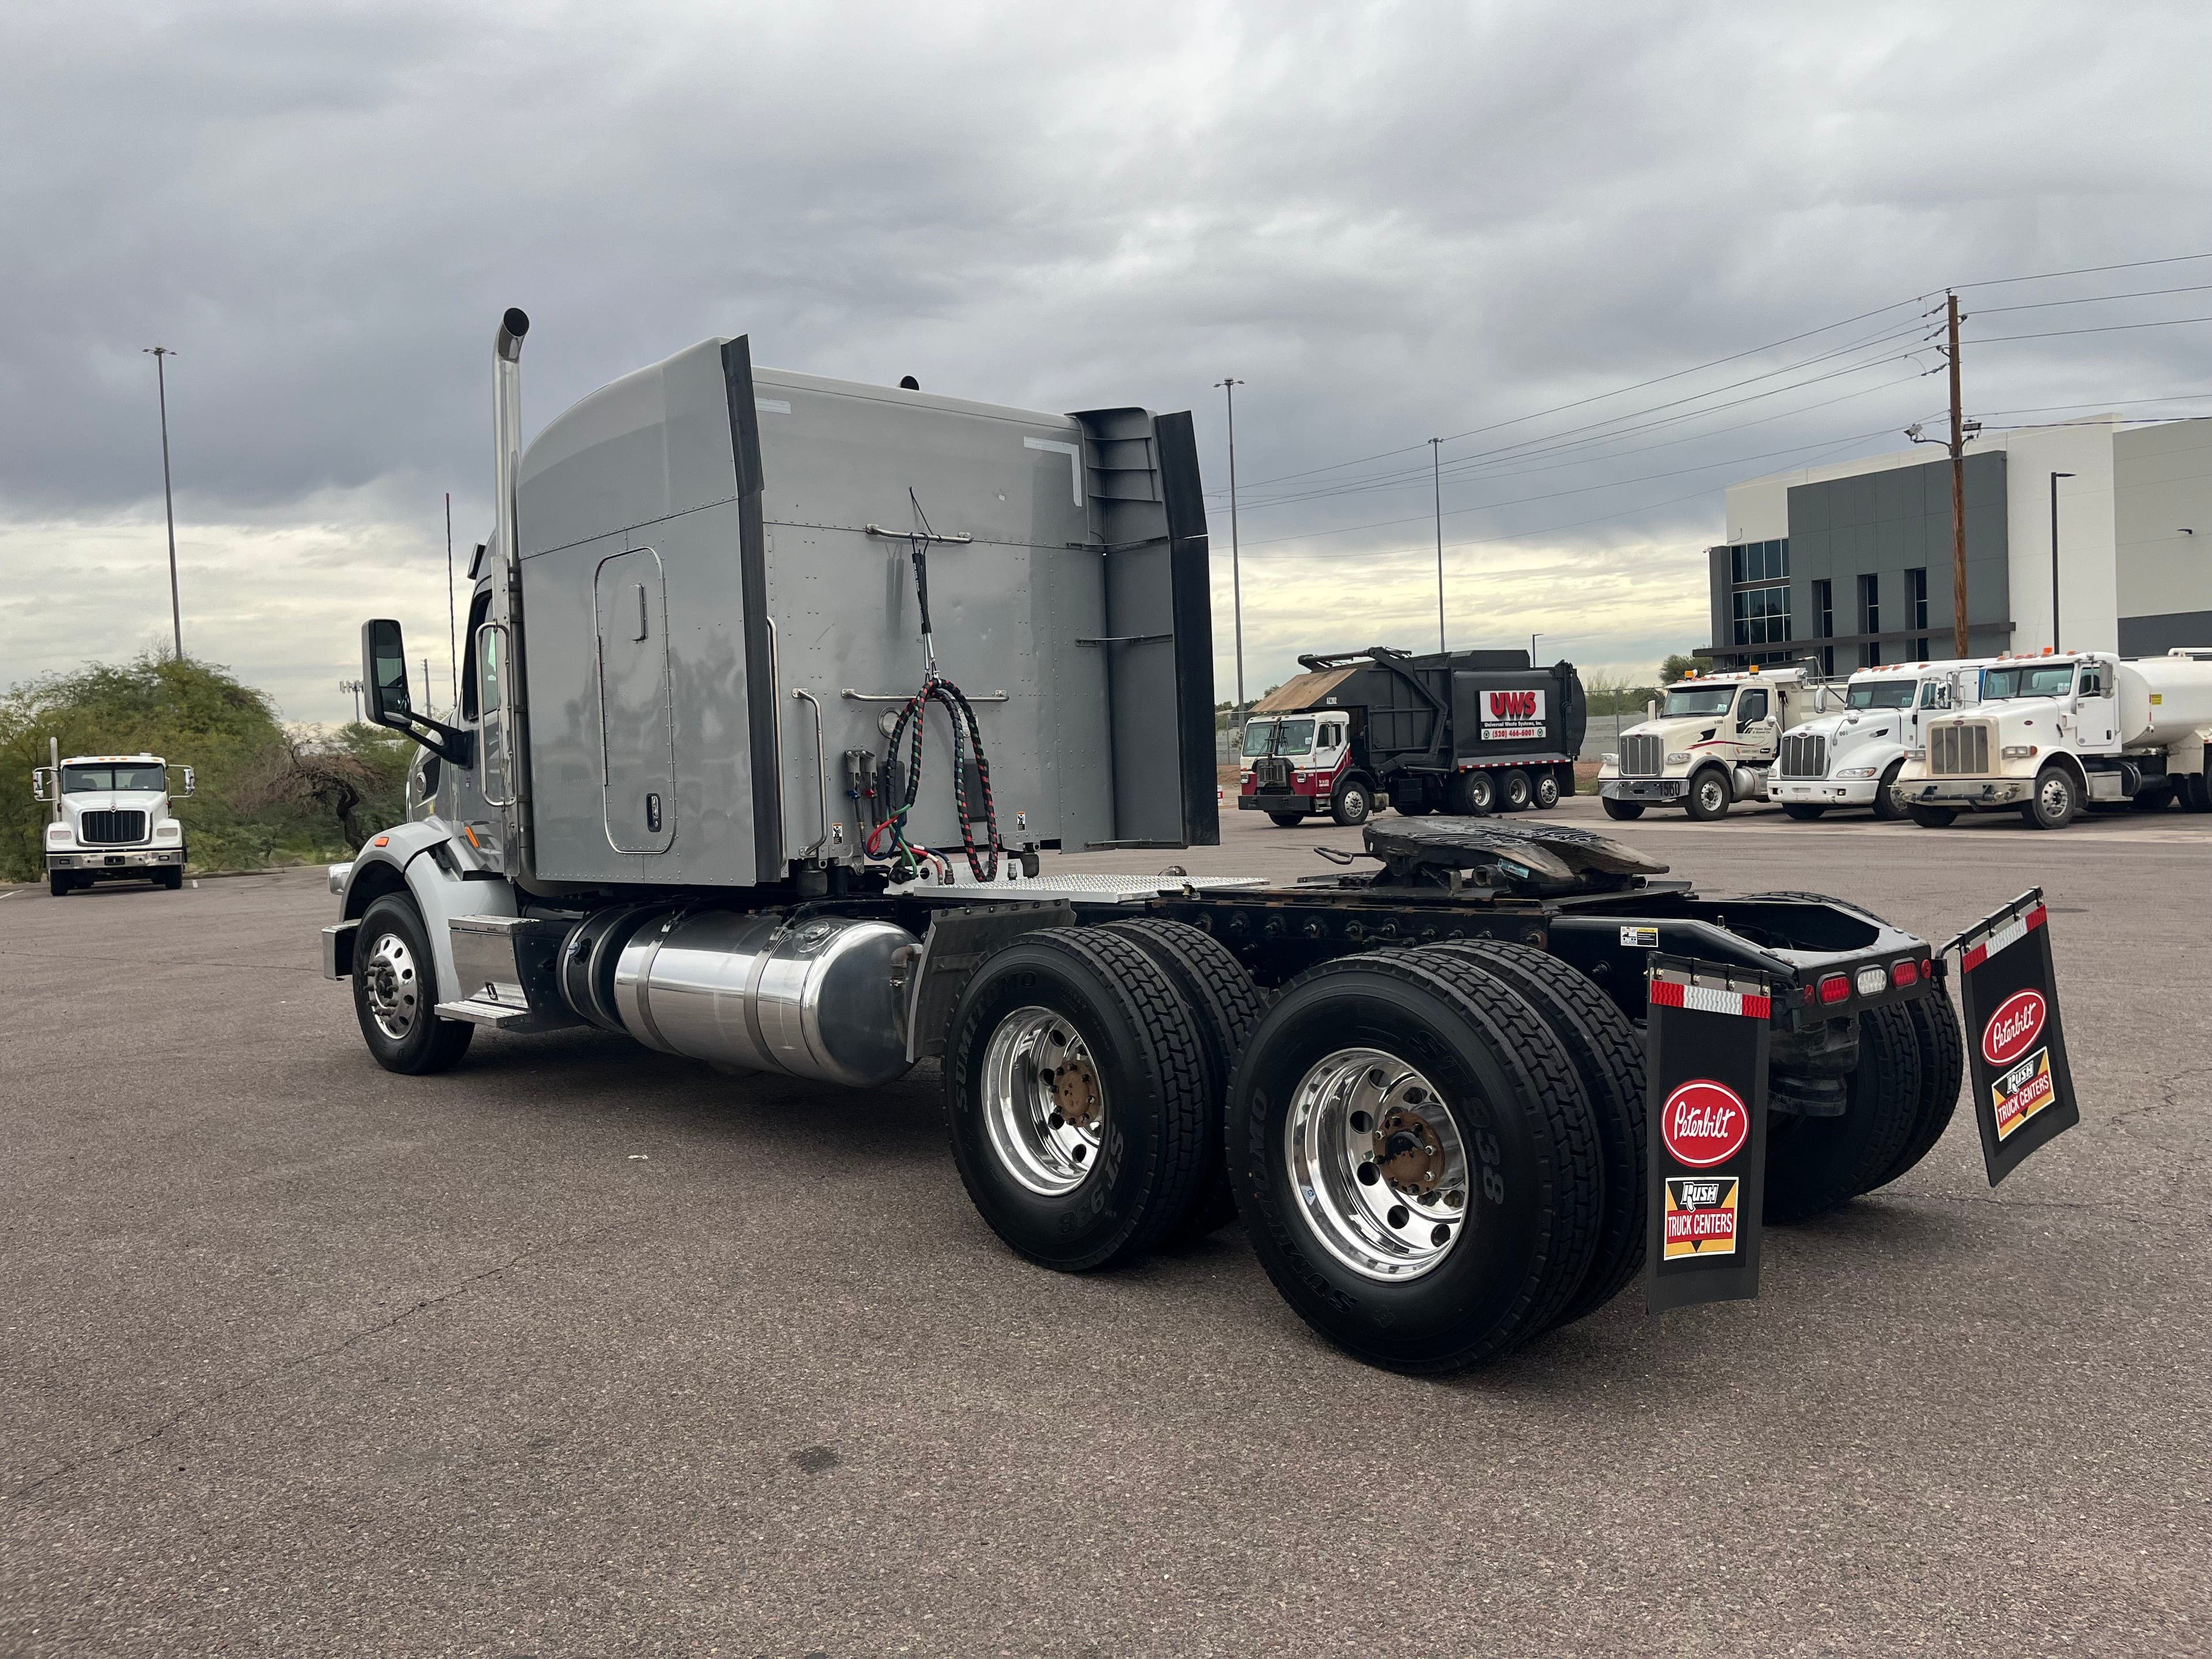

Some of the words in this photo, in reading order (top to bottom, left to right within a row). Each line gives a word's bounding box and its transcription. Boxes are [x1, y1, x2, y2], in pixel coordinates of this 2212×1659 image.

[1490, 692, 1536, 717] UWS
[1492, 730, 1507, 738] (520)
[1993, 1002, 2036, 1054] Peterbilt
[2006, 1060, 2034, 1094] RUSH
[1998, 1096, 2019, 1123] TRUCK
[2019, 1074, 2049, 1106] CENTERS
[1674, 1101, 1736, 1141] Peterbilt
[1461, 1096, 1505, 1206] 938
[1680, 1182, 1719, 1212] RUSH
[1668, 1214, 1692, 1237] TRUCK
[1694, 1213, 1733, 1236] CENTERS
